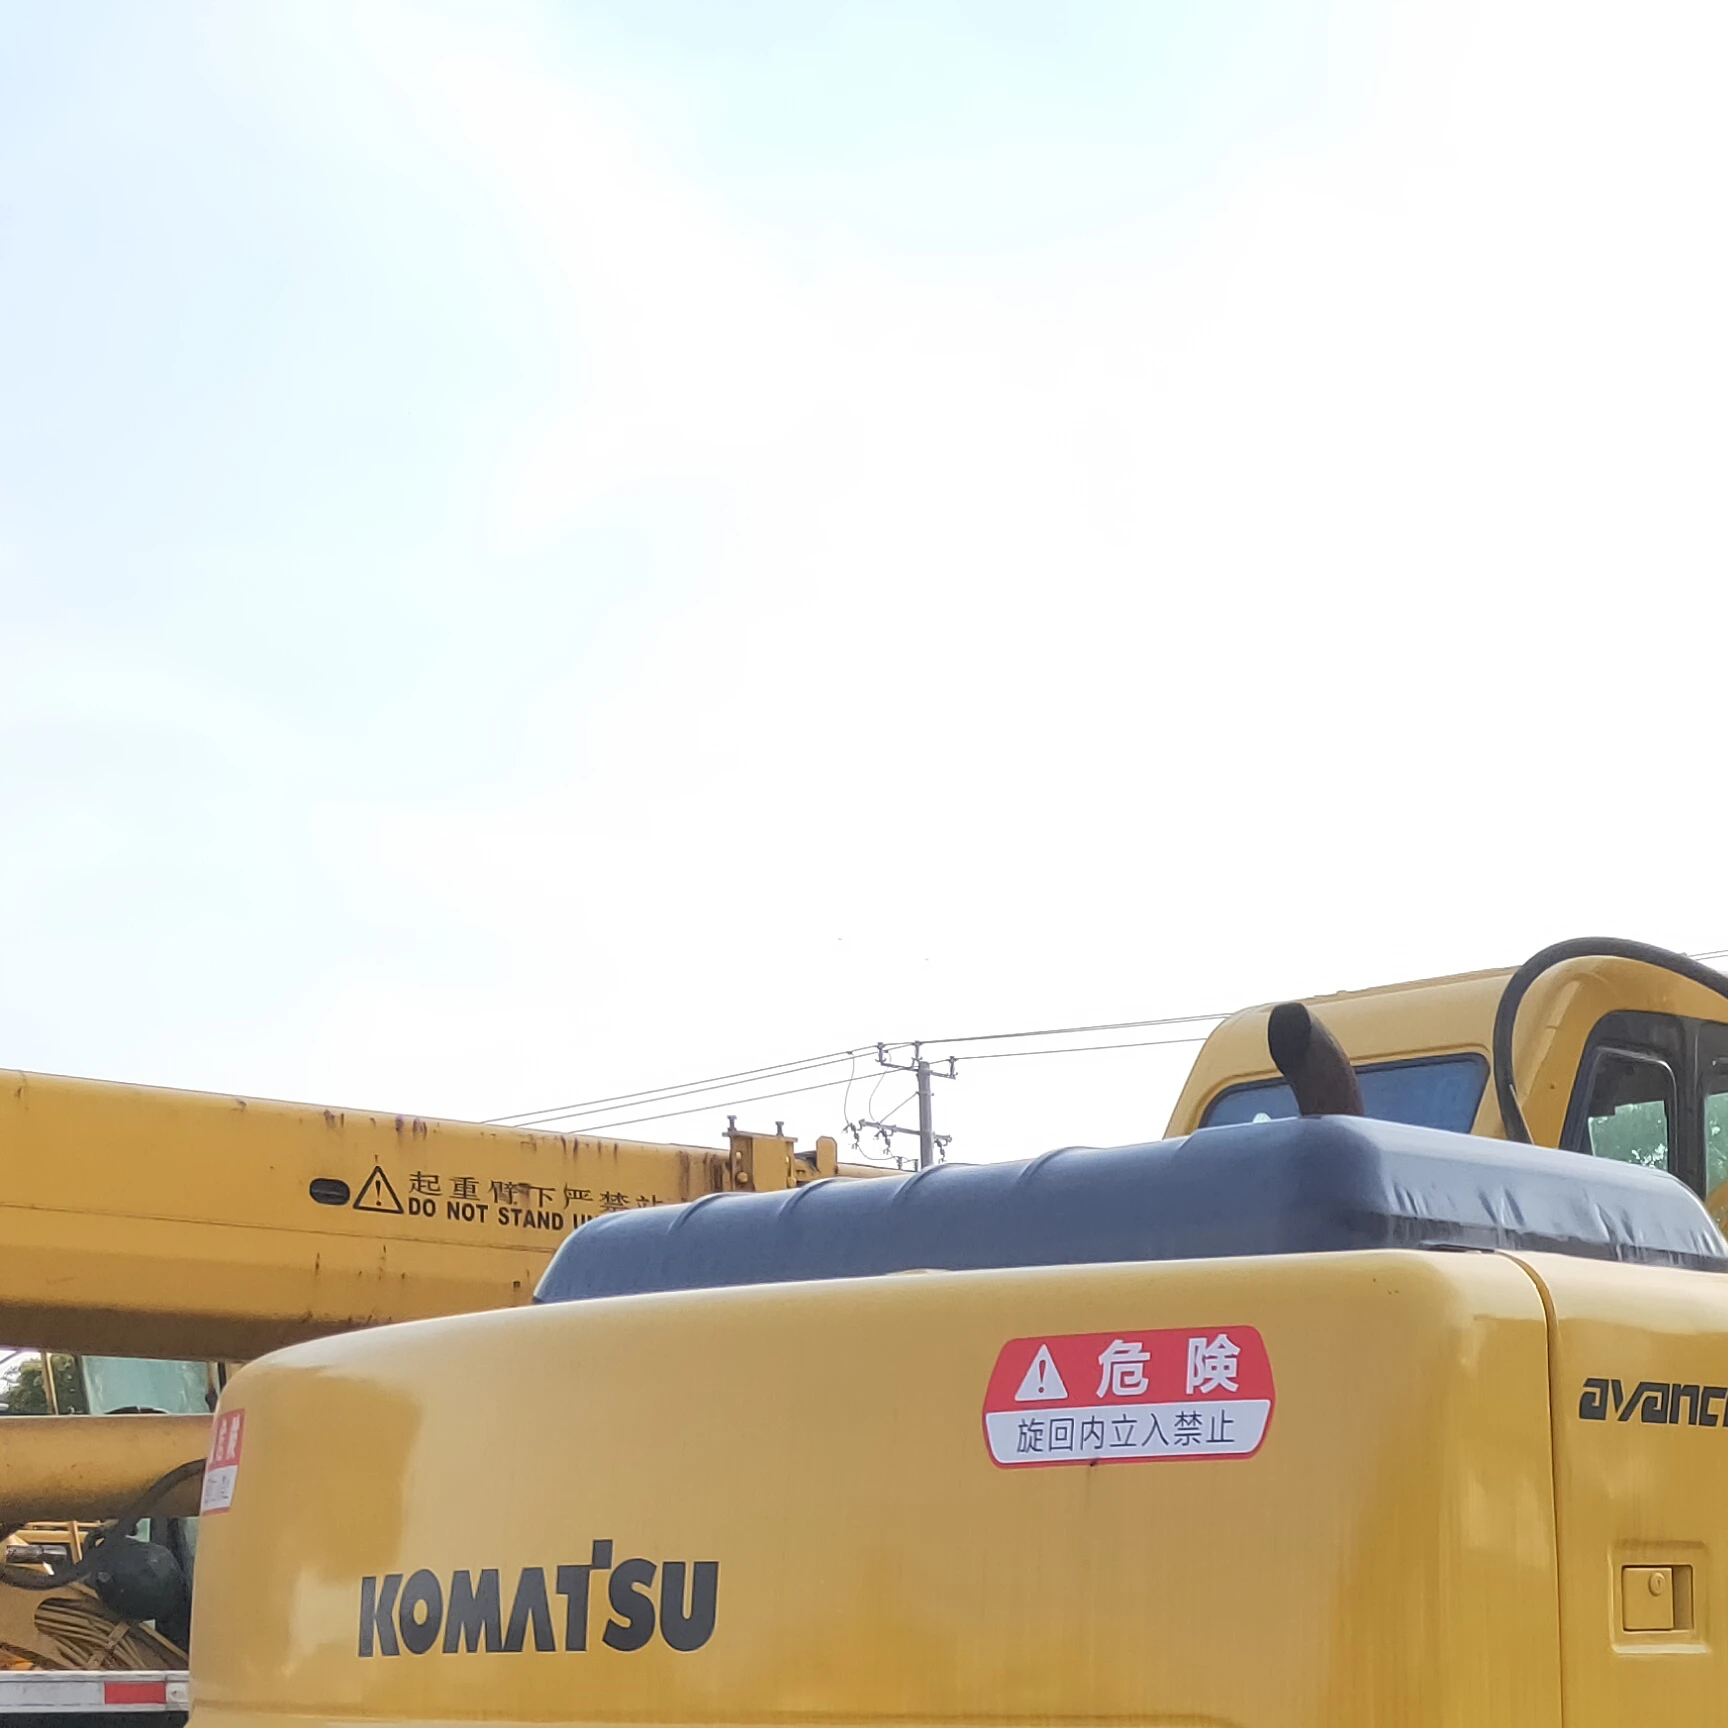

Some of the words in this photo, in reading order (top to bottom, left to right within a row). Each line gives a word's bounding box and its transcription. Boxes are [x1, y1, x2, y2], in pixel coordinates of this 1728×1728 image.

[408, 1197, 436, 1218] DO
[447, 1200, 489, 1223] NOT
[498, 1206, 564, 1231] STAND
[1016, 1409, 1235, 1453] 旋回内立入禁止
[358, 1539, 720, 1657] KOMATSU
